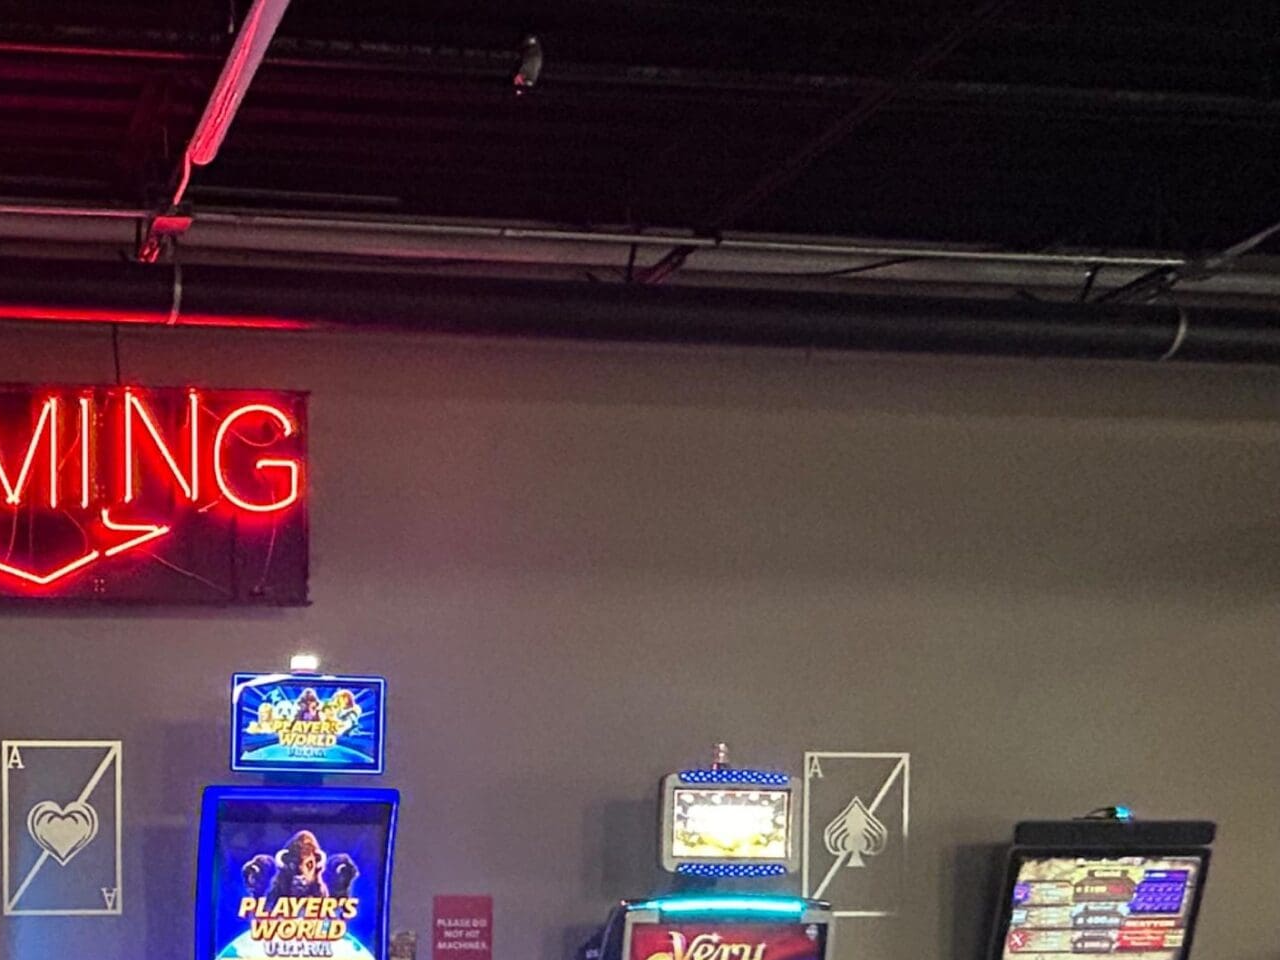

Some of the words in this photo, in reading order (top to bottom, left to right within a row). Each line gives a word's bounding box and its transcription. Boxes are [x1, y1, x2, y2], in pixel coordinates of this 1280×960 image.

[279, 732, 336, 748] WORLD
[8, 742, 25, 769] A
[808, 755, 824, 778] A
[238, 896, 359, 919] PLAYER'S
[251, 918, 347, 941] WORLD
[263, 941, 333, 958] ULTRA
